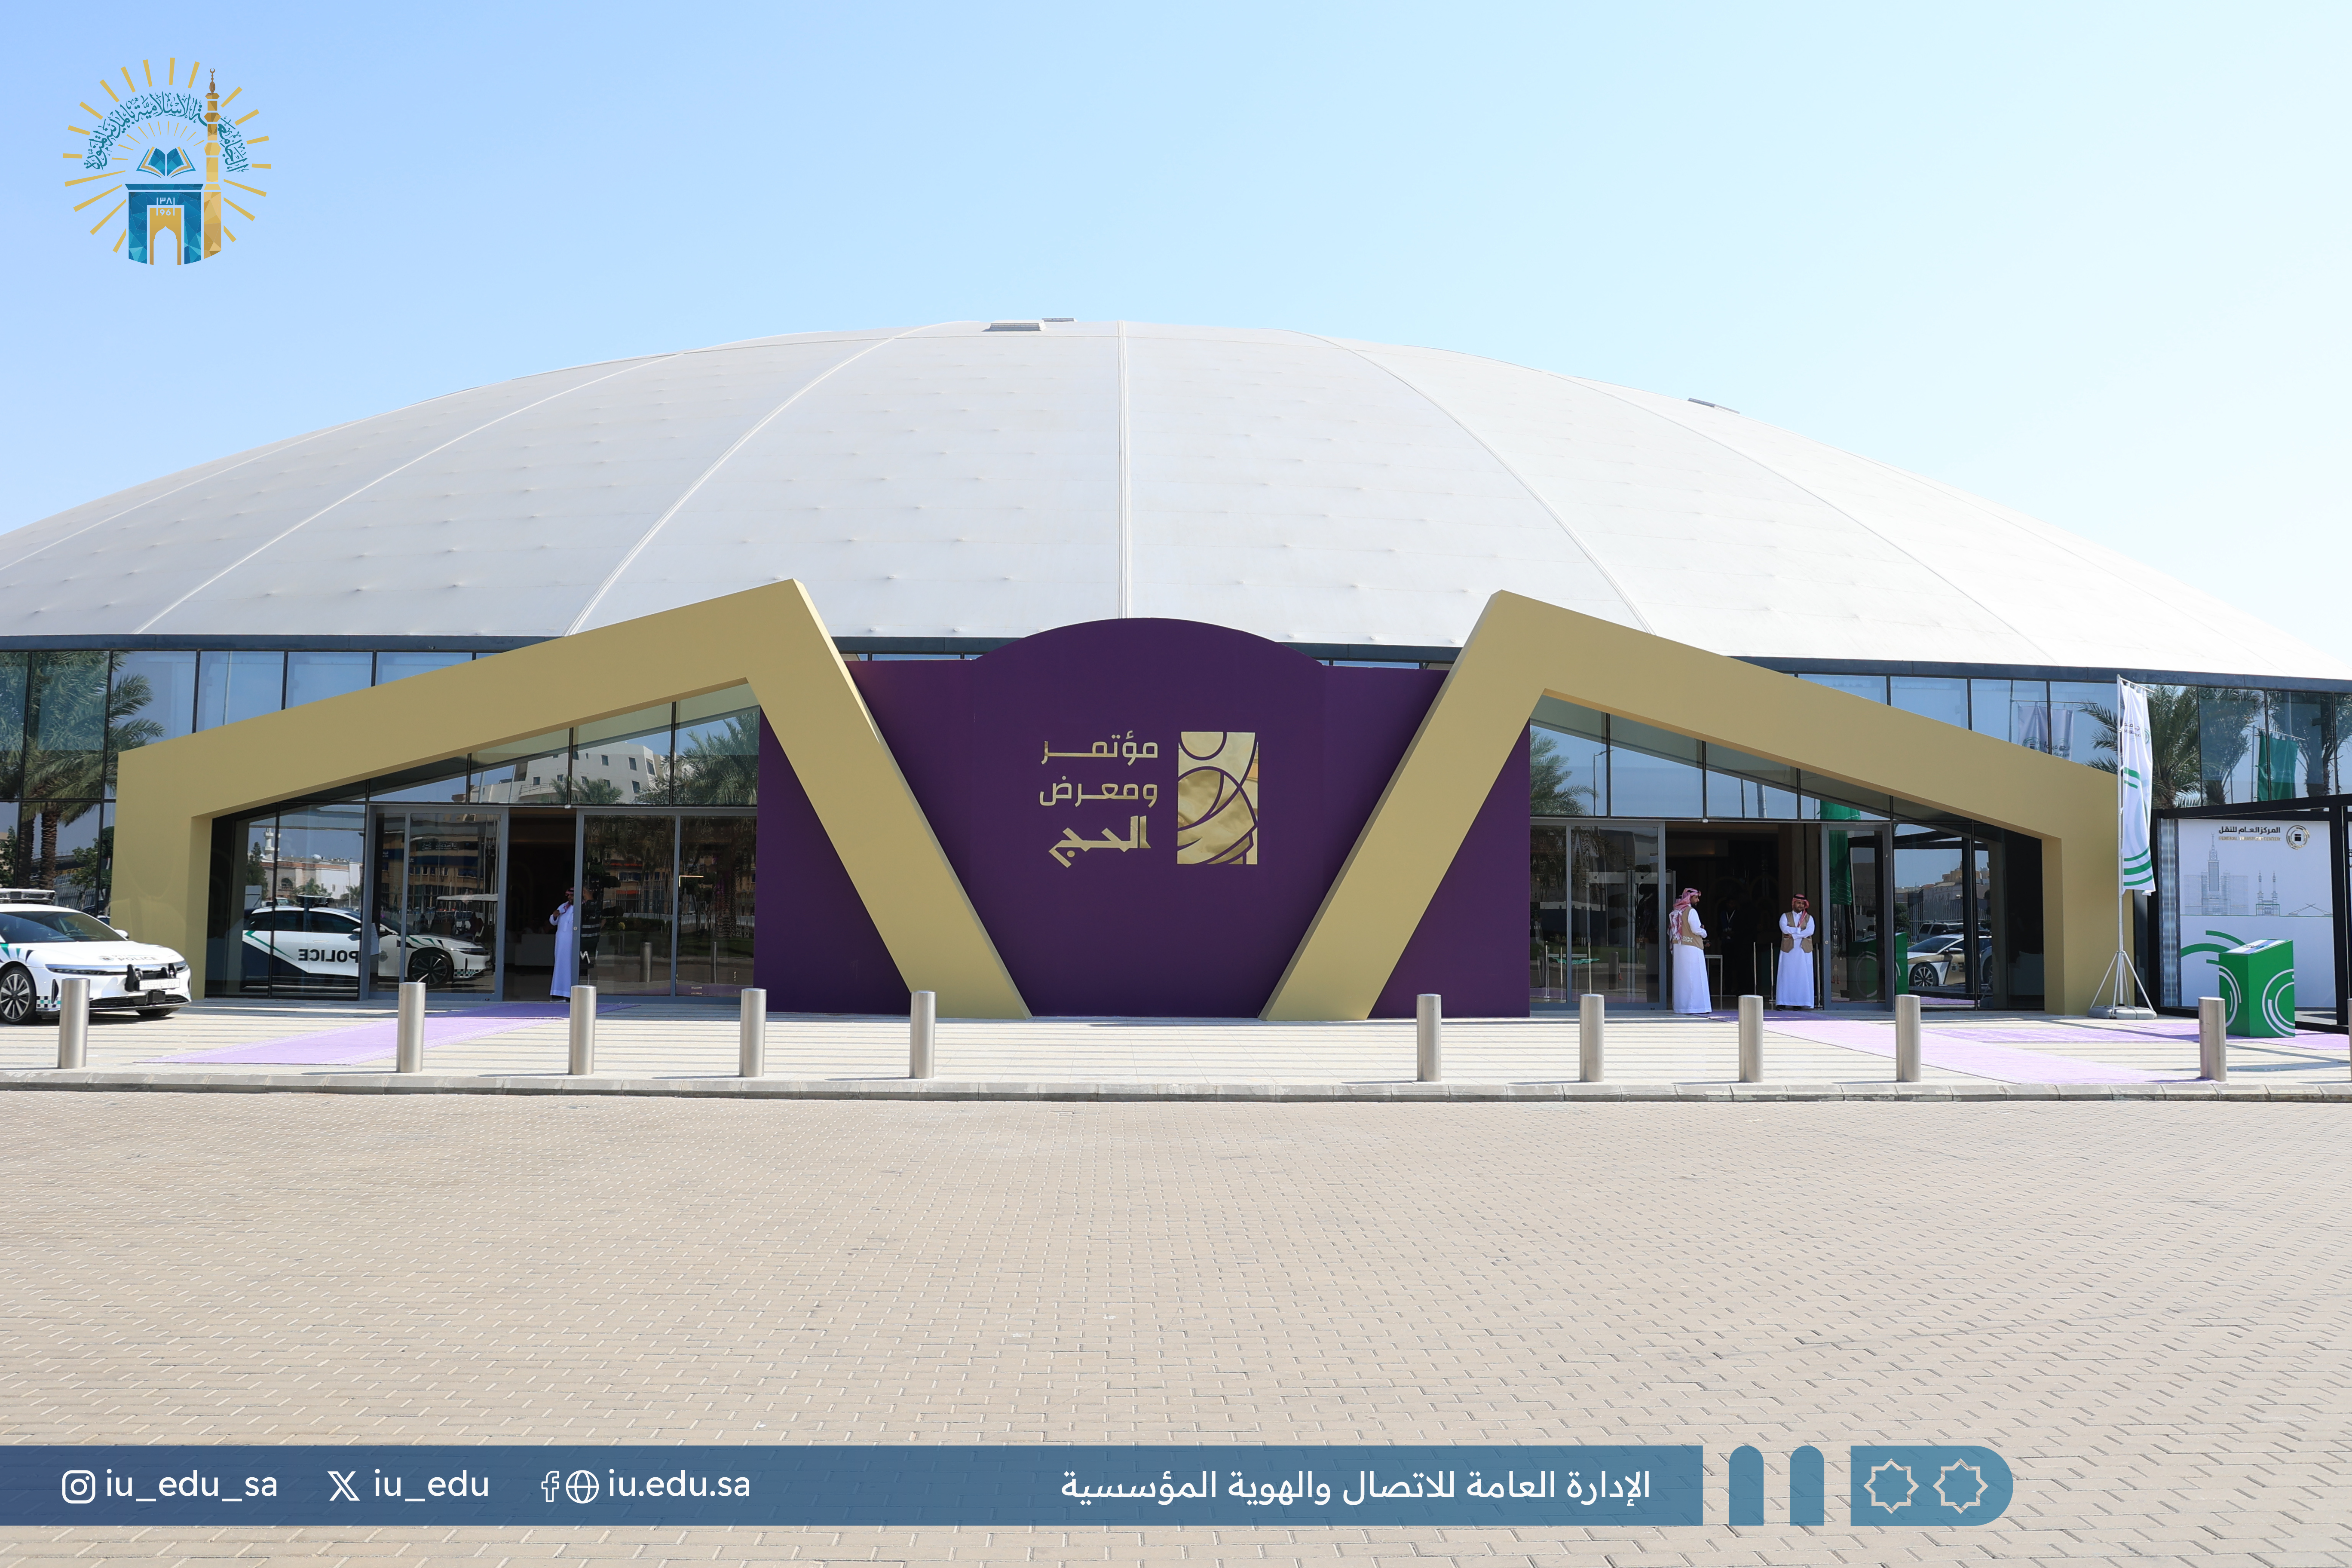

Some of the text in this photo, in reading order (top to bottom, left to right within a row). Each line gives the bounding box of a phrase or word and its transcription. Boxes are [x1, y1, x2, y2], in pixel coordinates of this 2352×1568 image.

[1041, 730, 1158, 766] مؤتمر
[1039, 775, 1158, 808] ومعرض
[1048, 815, 1151, 868] الحج
